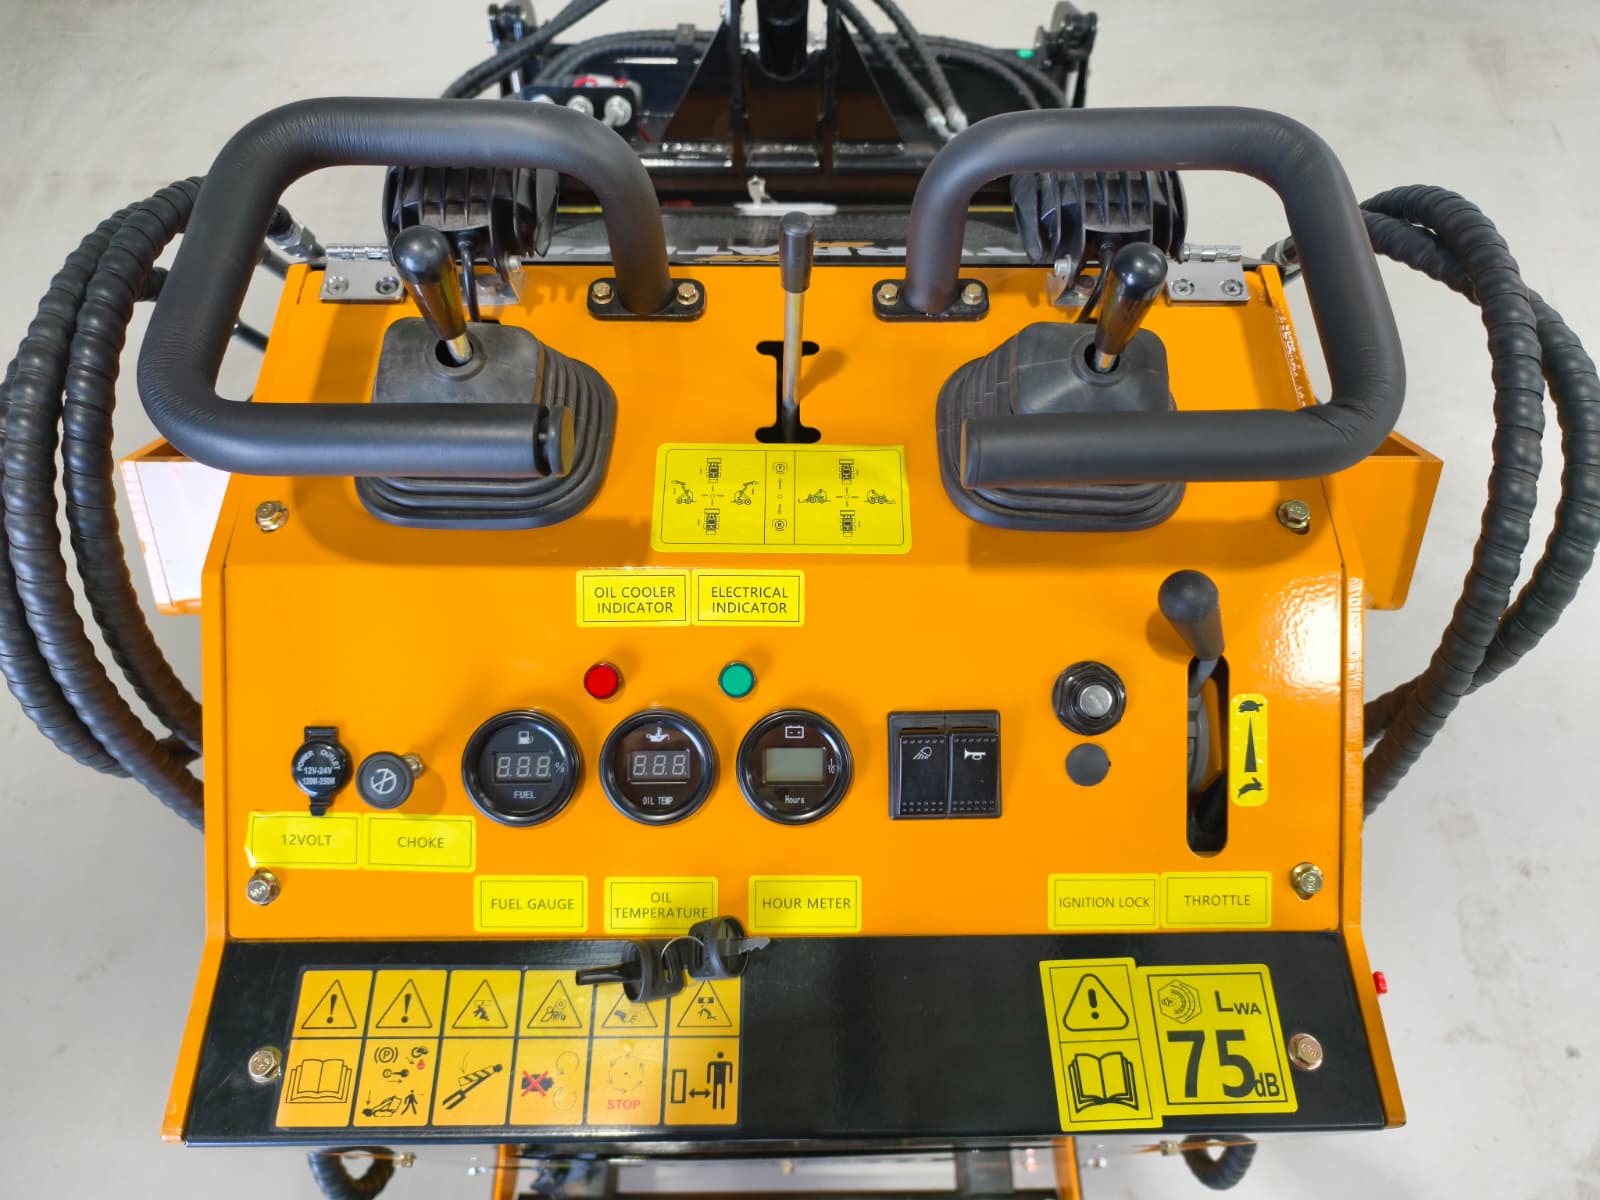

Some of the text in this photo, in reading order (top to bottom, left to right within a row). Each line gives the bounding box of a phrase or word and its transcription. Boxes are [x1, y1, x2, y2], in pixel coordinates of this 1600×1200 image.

[594, 586, 676, 598] OIL COOLER
[711, 586, 789, 598] ELECTRICAL
[597, 602, 673, 614] INDICATOR
[712, 602, 787, 614] INDICATOR
[513, 790, 536, 799] FUEL
[642, 796, 655, 805] OIL
[784, 794, 805, 804] Hours
[281, 834, 332, 847] 12VOLT
[397, 836, 444, 849] CHOKE
[650, 891, 672, 904] OIL
[762, 898, 851, 909] HOUR METER
[1059, 896, 1151, 909] IGNITION LOCK
[1184, 894, 1251, 906] THROTTLE
[491, 898, 575, 910] FUEL GAUGE
[614, 907, 708, 919] TEMPERATURE
[607, 1099, 641, 1110] STOP
